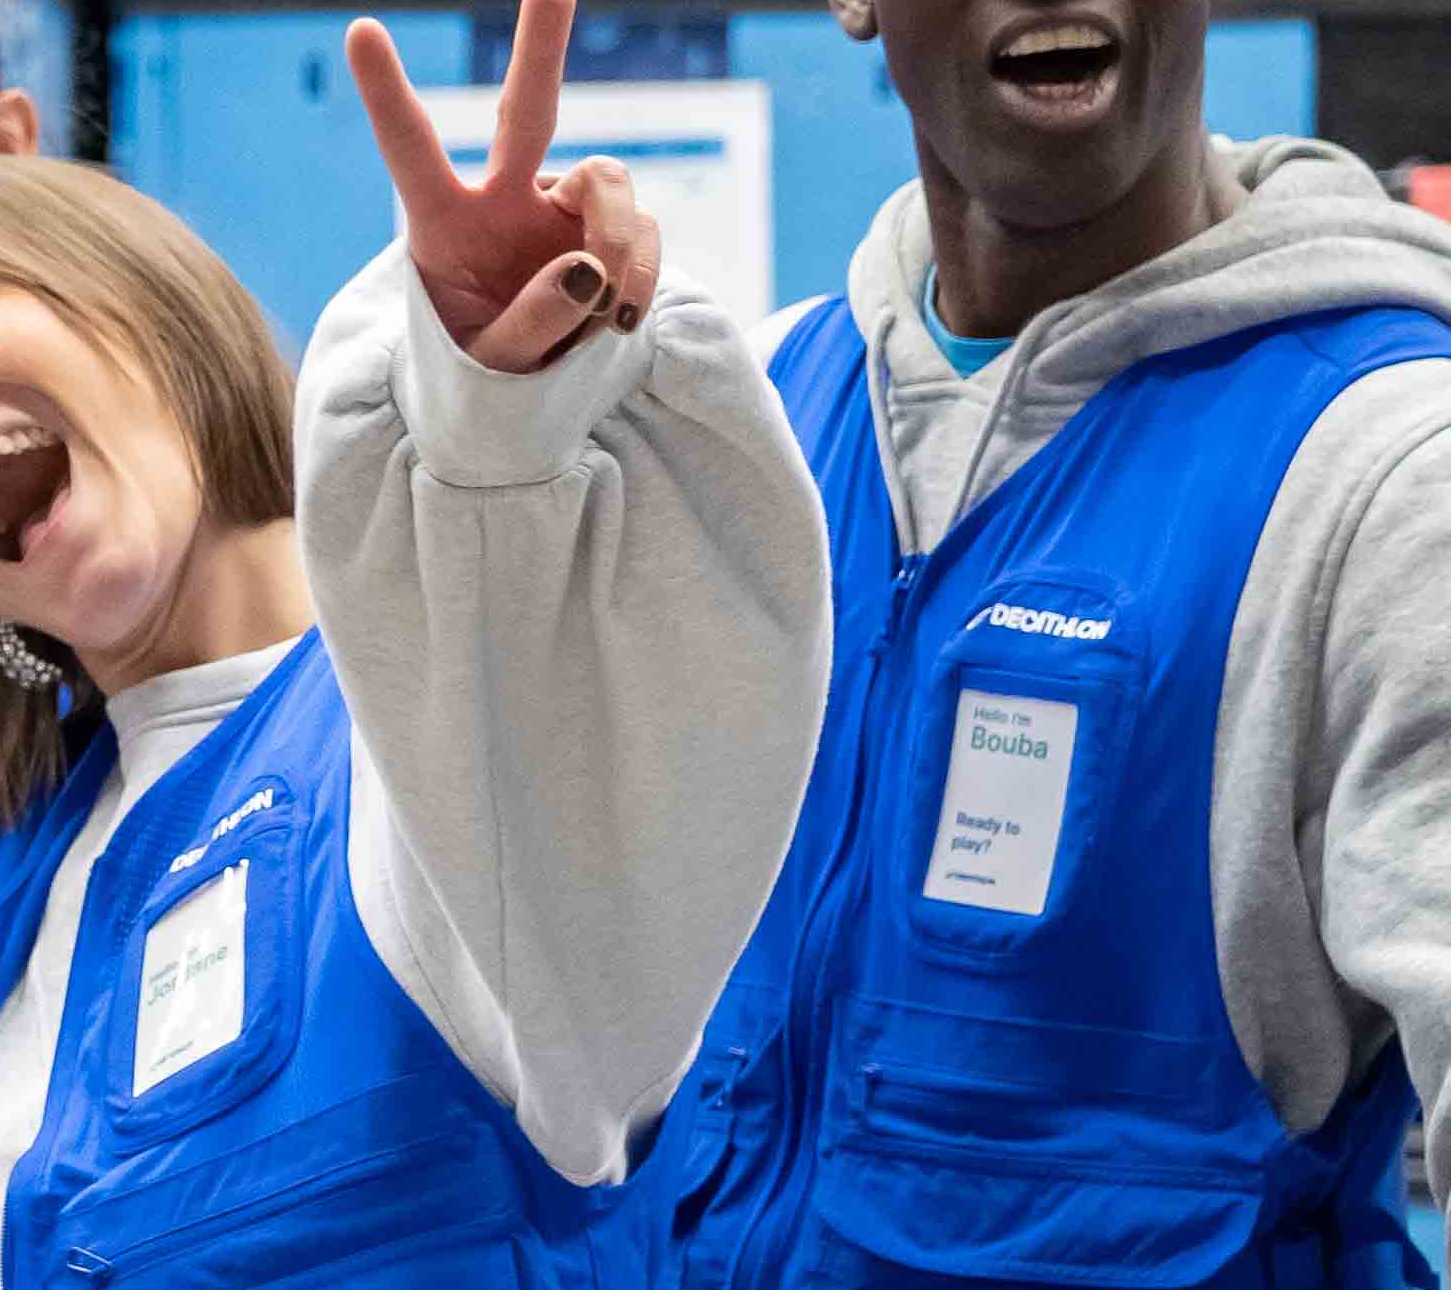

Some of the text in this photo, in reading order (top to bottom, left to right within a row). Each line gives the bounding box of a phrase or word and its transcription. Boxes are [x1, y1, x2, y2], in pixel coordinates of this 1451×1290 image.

[990, 602, 1112, 640] DECATHLON
[970, 725, 1049, 760] Bouba
[956, 811, 1021, 837] Ready to
